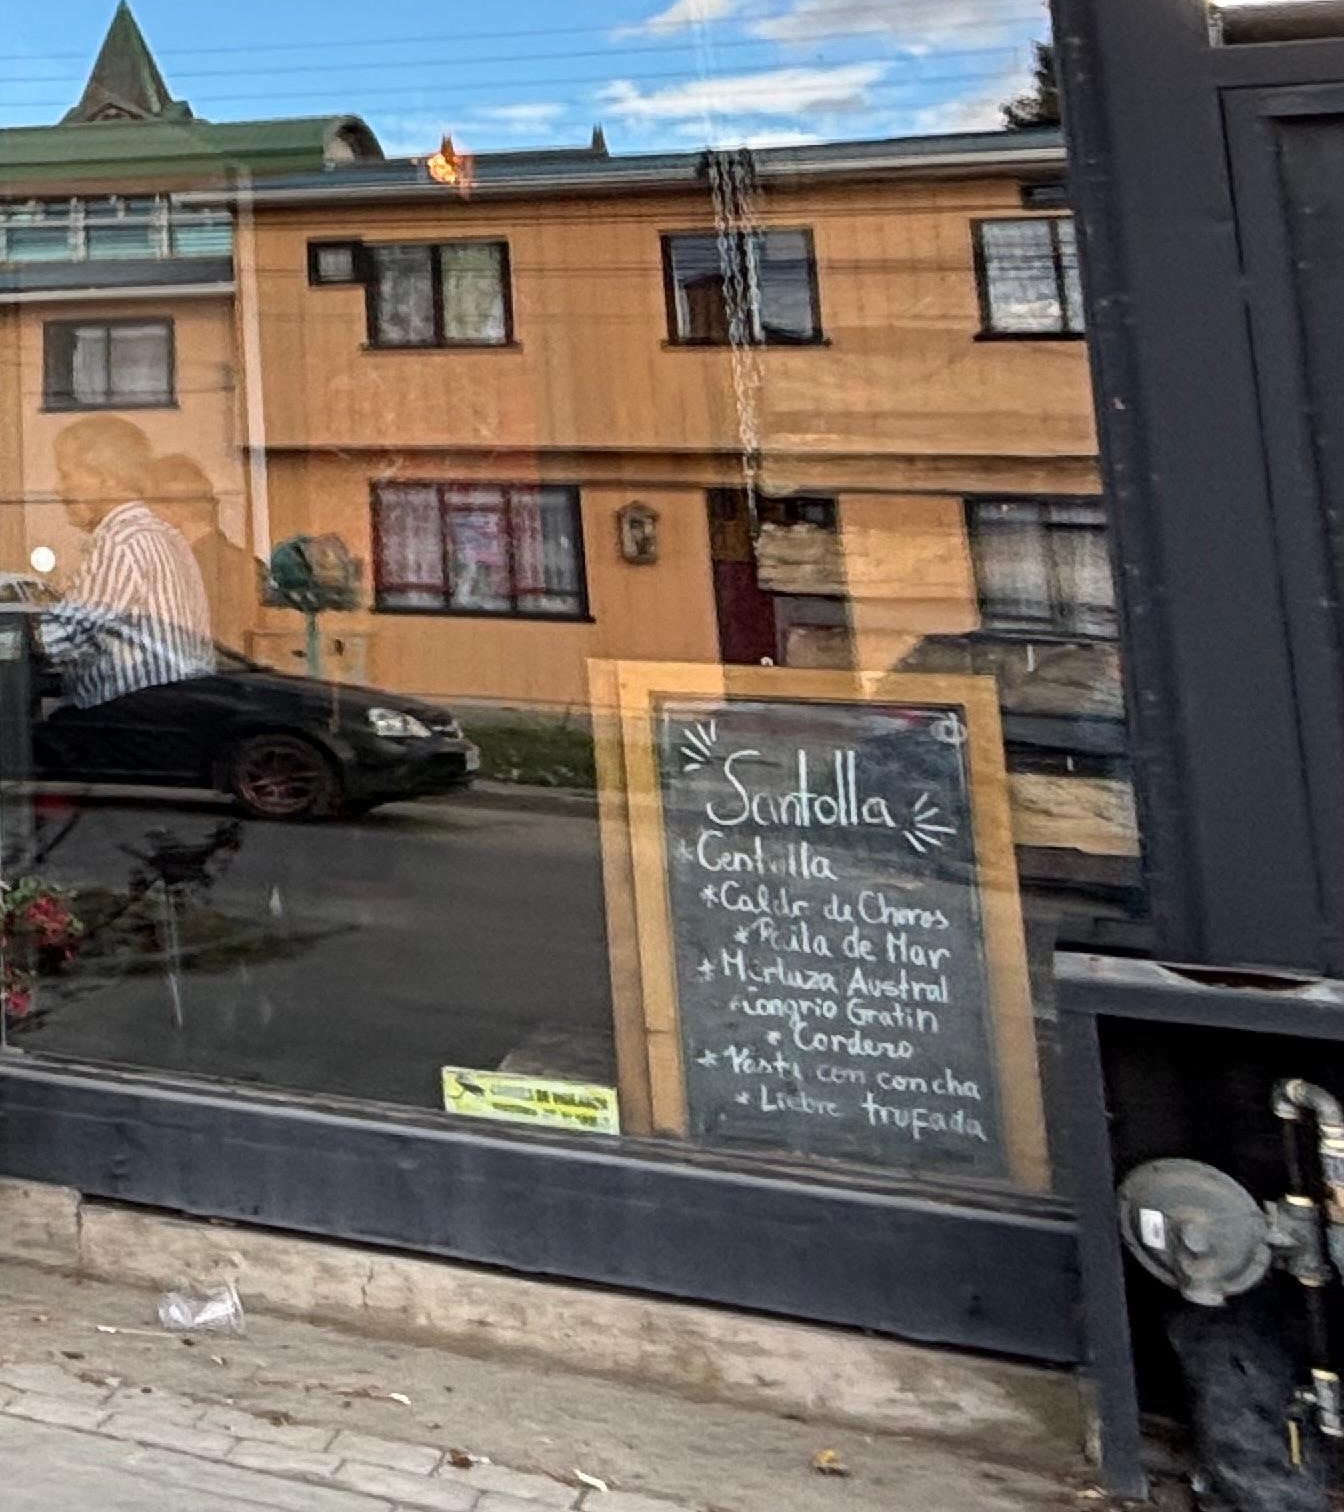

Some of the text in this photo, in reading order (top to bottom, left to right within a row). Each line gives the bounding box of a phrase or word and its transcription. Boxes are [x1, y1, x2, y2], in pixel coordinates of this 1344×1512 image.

[706, 749, 896, 829] Santolla
[842, 926, 878, 961] de
[886, 932, 951, 970] Mar
[847, 967, 951, 1004] Austral
[815, 1063, 867, 1086] con
